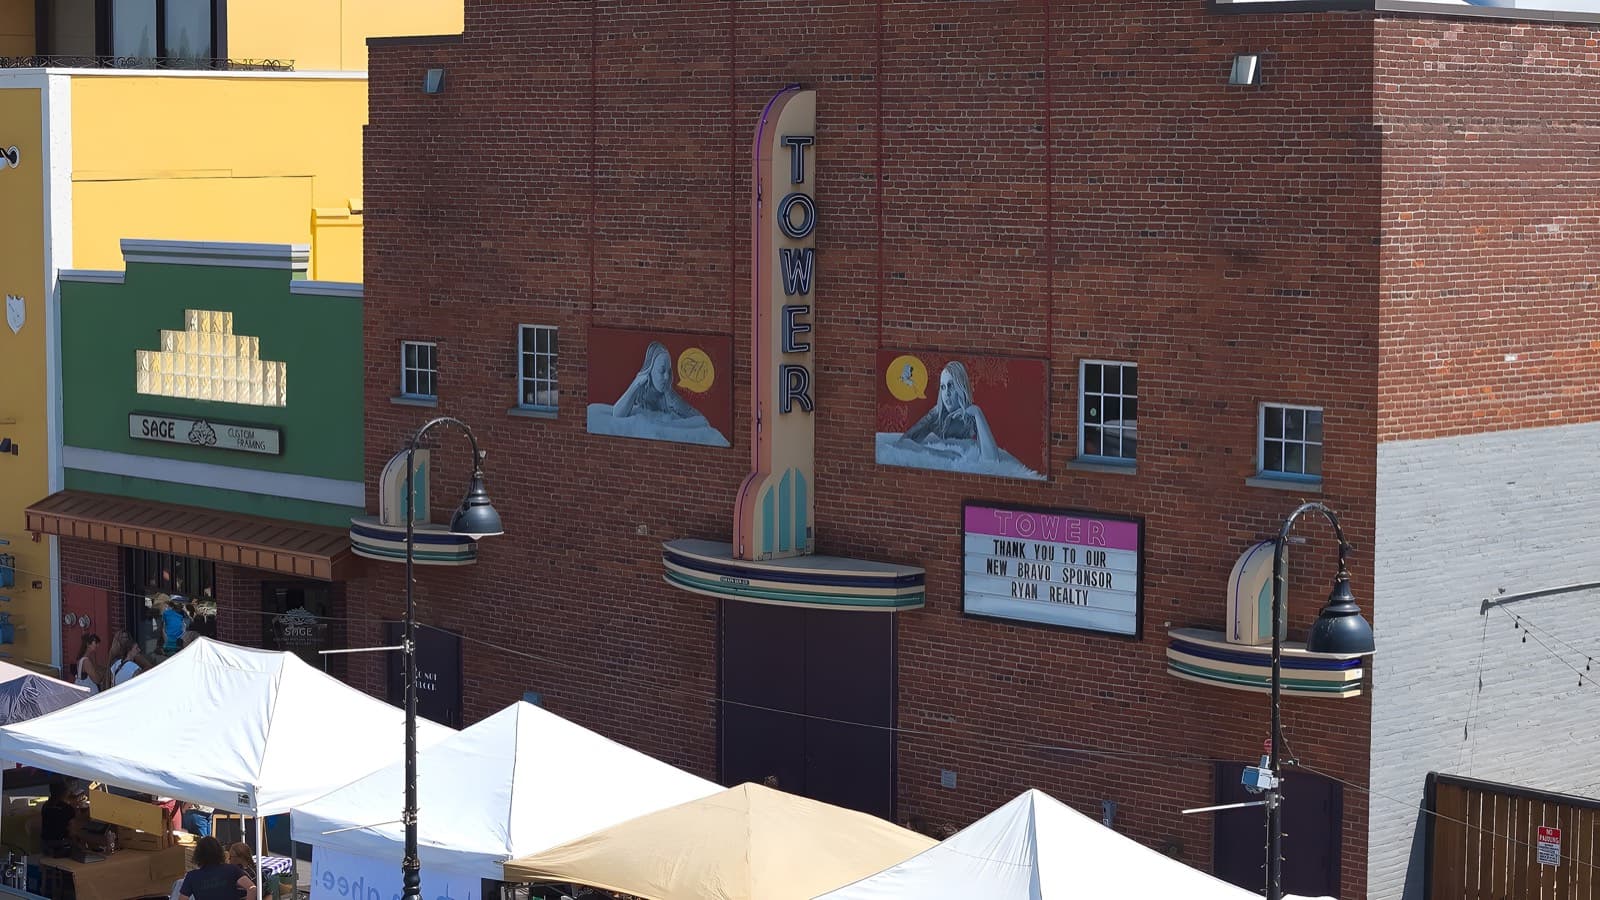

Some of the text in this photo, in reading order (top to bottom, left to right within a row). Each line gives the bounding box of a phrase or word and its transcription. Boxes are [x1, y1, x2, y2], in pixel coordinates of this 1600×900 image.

[777, 135, 816, 413] TOWER
[142, 418, 176, 439] SAGE
[227, 427, 255, 439] CUSTOM
[236, 438, 266, 450] FRAMING
[994, 510, 1106, 545] TOWER
[993, 539, 1107, 568] THANK YOU TO OUR
[986, 558, 1113, 589] NEW BRAVO SPONSOR
[1011, 581, 1089, 606] RYAN REALTY
[284, 627, 313, 637] SAGE
